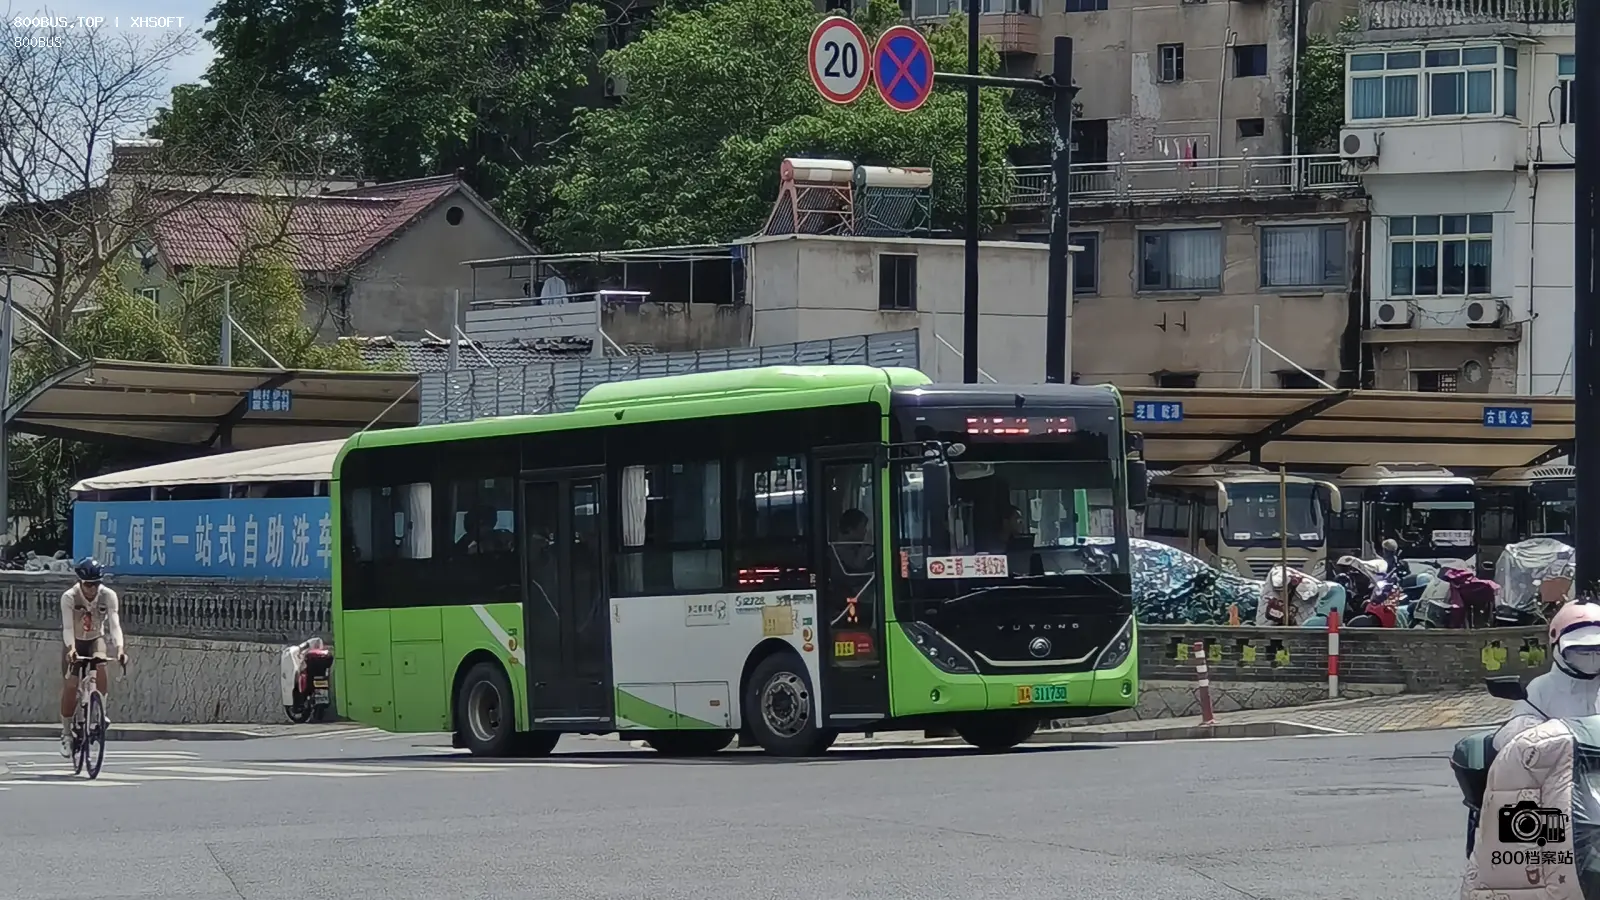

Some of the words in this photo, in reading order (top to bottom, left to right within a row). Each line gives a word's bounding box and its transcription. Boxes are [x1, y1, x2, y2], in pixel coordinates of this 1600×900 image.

[824, 41, 858, 78] 20
[128, 512, 332, 569] 便民一站式自助洗车
[997, 622, 1079, 631] YUTONG
